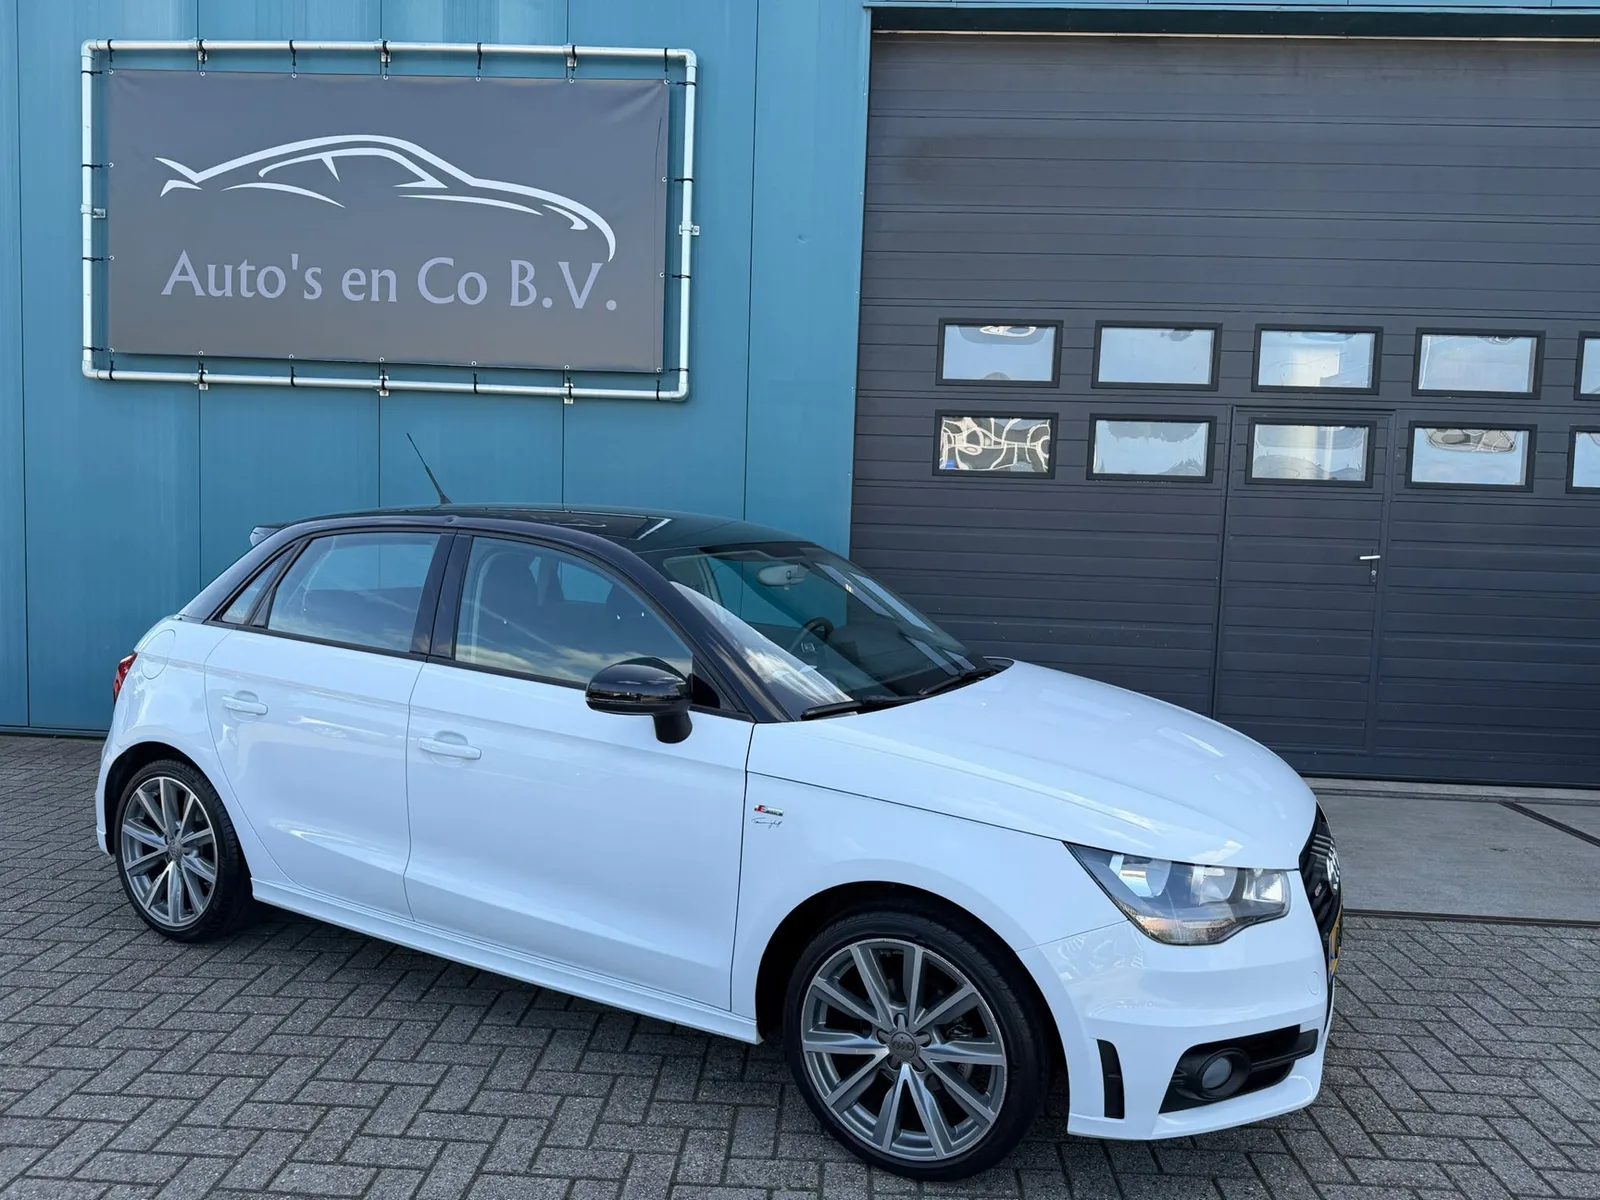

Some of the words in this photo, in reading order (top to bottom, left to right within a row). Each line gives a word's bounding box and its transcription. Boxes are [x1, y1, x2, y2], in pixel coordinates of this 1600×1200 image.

[161, 250, 323, 300] Auto's
[341, 268, 399, 303] en
[417, 256, 488, 306] Co
[509, 259, 618, 311] B.V.
